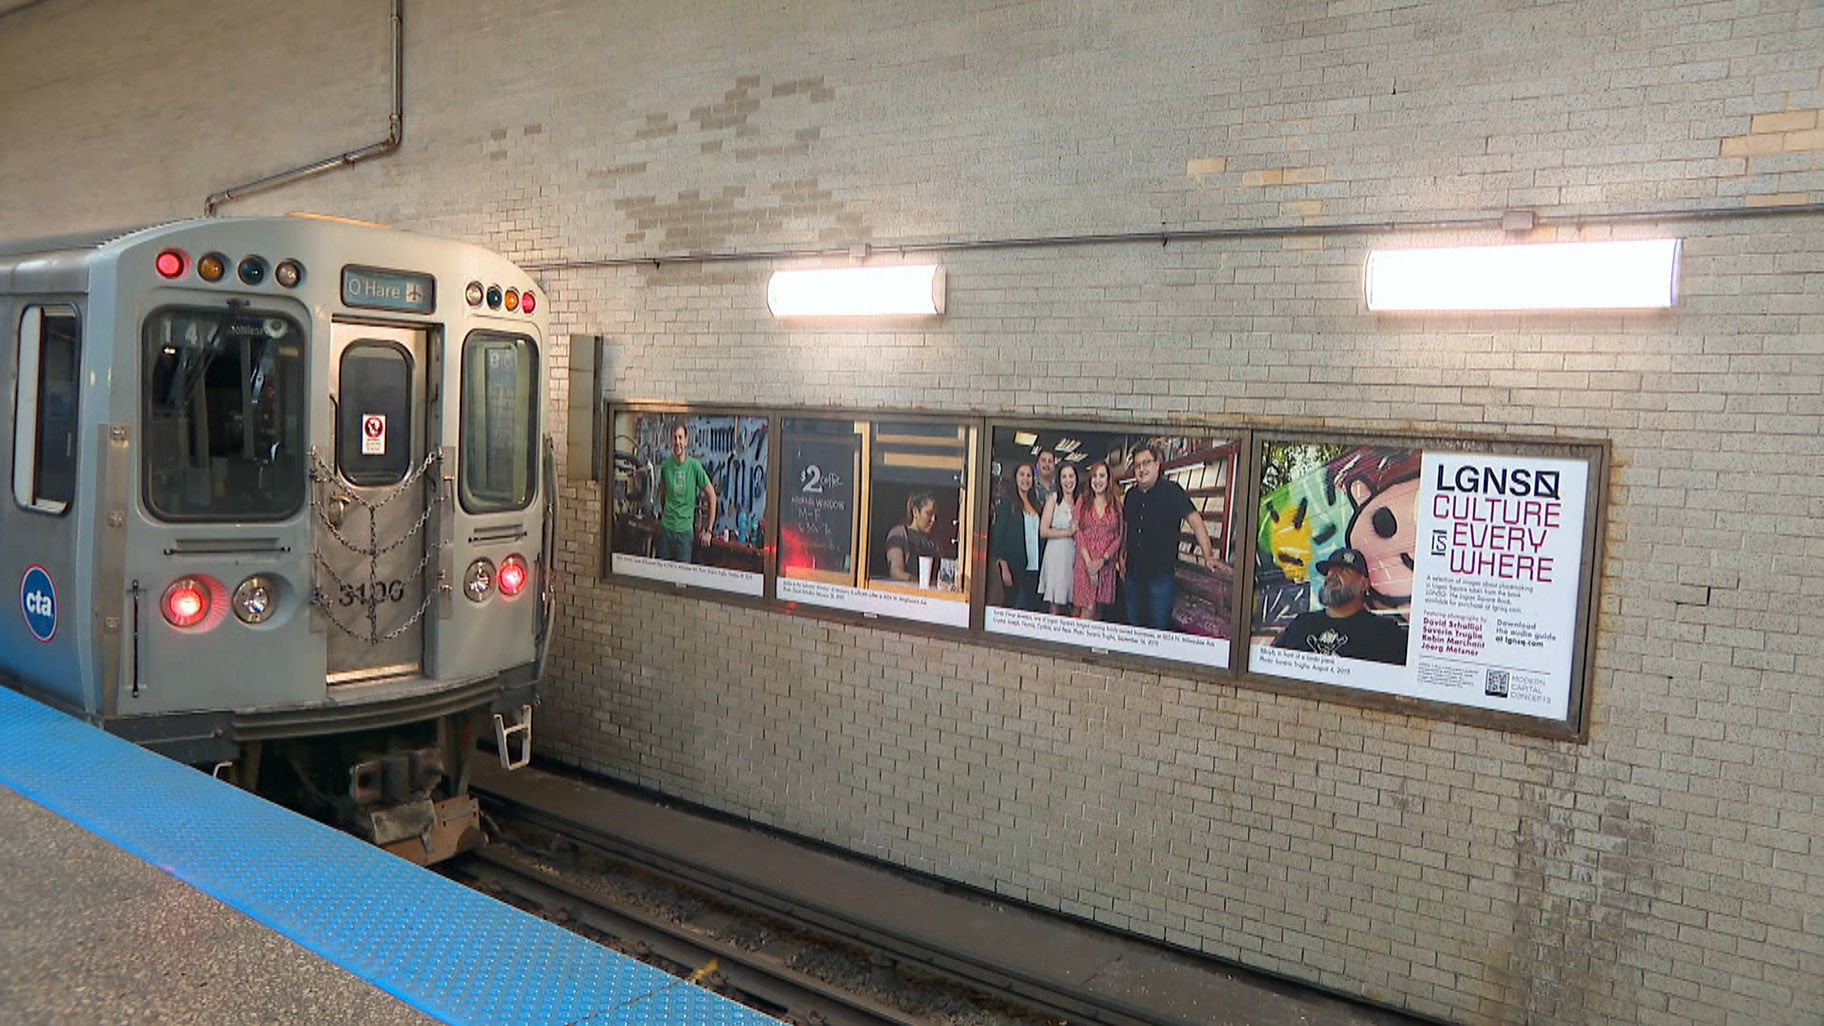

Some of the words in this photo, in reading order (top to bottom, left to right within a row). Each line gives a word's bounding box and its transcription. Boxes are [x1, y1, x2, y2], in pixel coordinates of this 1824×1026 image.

[1436, 464, 1560, 500] LGNSQ
[1432, 494, 1561, 528] CULTURE
[1431, 533, 1448, 553] IS
[1452, 522, 1547, 553] EVERY
[1449, 549, 1554, 583] WHERE
[26, 590, 52, 617] cta
[1423, 617, 1447, 627] David
[1496, 619, 1537, 630] Download
[1510, 630, 1533, 638] audio
[1534, 632, 1557, 641] guide
[1421, 642, 1444, 653] Joerg
[1510, 684, 1542, 694] CAPITAL
[1511, 675, 1545, 687] MODERN
